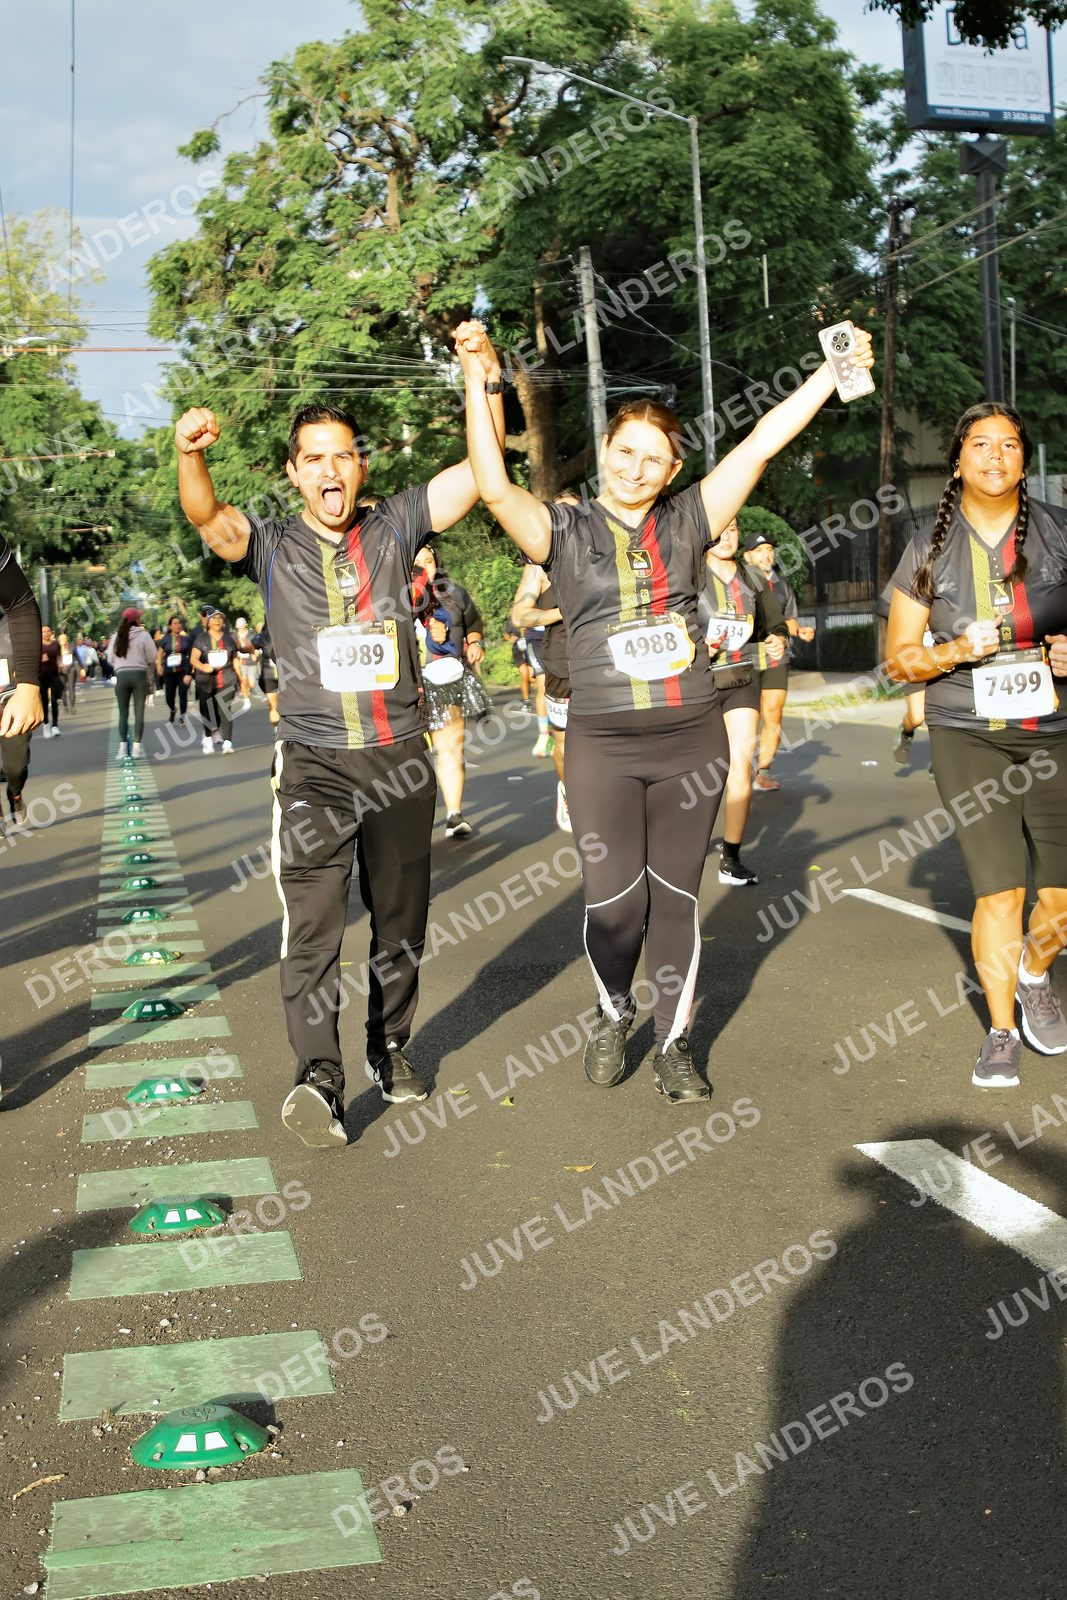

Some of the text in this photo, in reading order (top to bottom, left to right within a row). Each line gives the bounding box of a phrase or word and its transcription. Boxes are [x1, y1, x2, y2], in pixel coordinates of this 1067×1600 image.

[330, 643, 385, 667] 4989
[624, 631, 678, 658] 4988
[985, 671, 1042, 697] 7499
